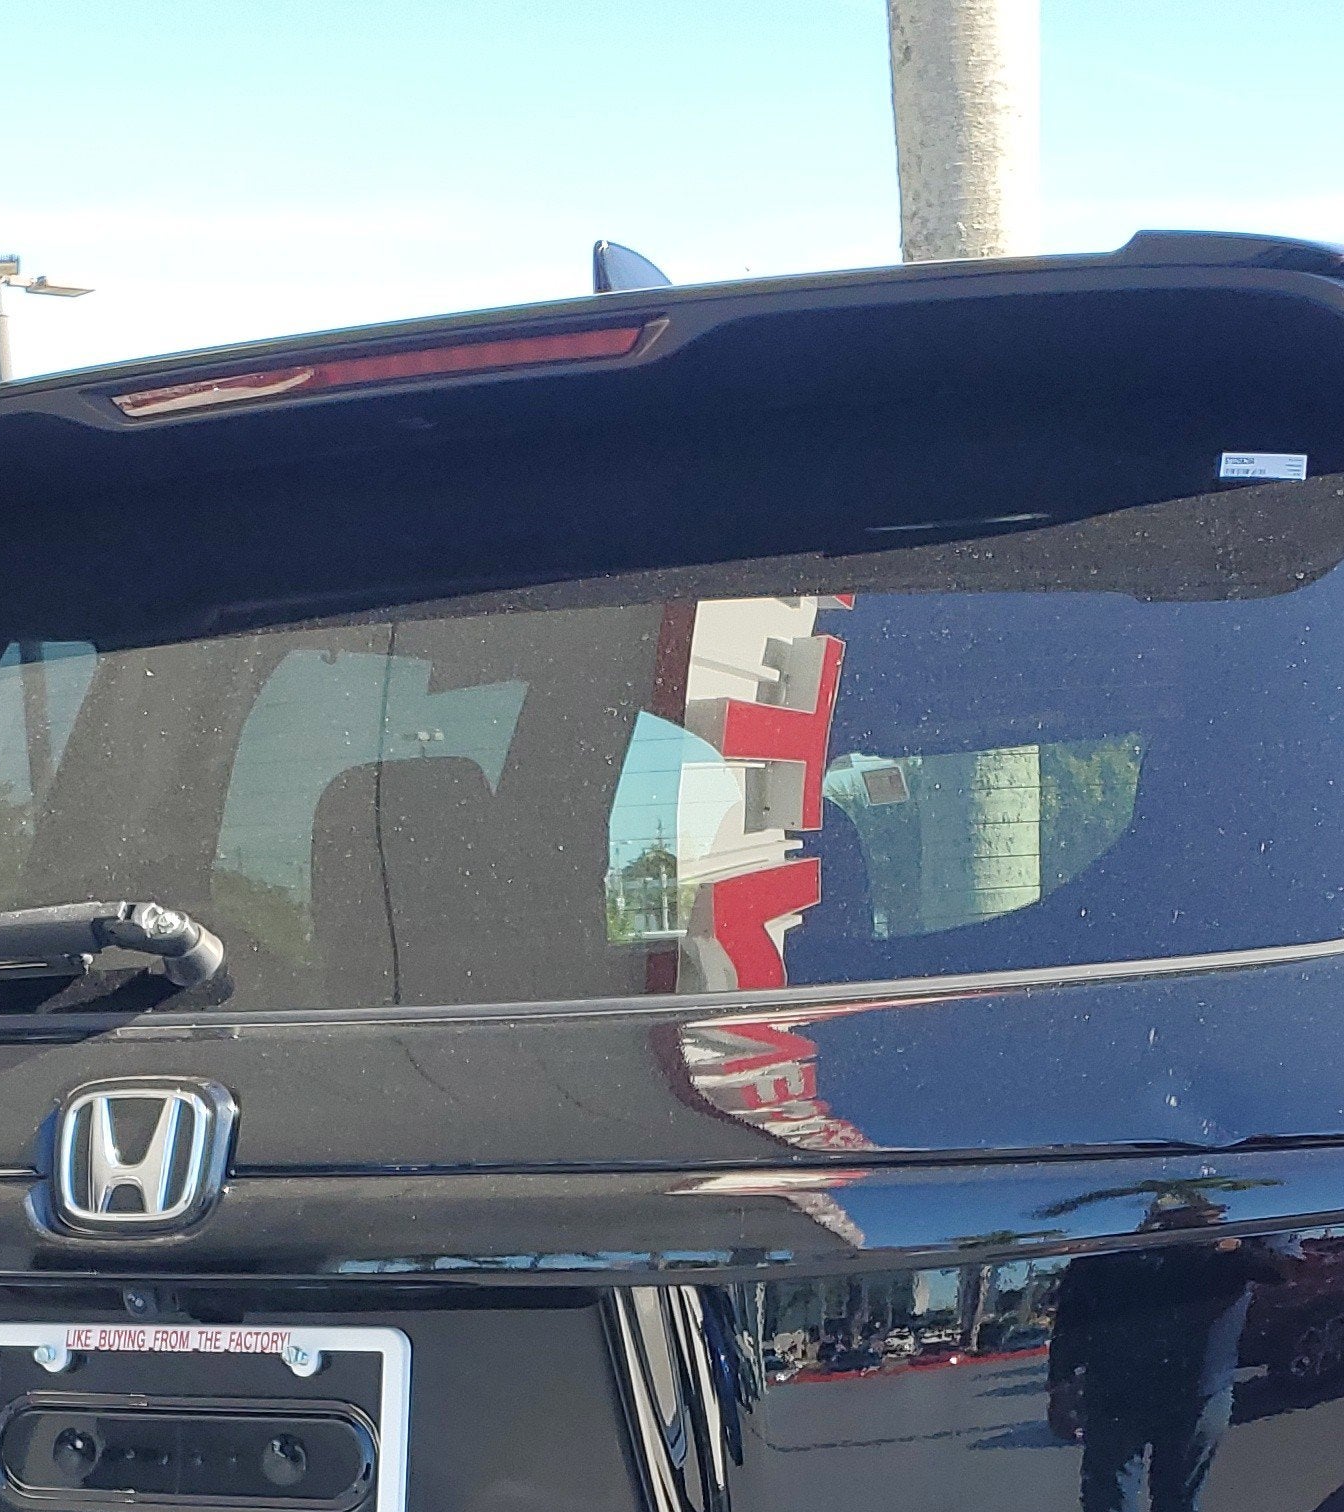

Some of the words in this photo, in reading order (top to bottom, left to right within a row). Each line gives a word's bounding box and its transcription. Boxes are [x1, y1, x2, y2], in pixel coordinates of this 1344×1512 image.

[65, 1329, 93, 1348] LIKE
[98, 1329, 146, 1349] BUYING
[153, 1330, 190, 1349] FROM
[197, 1331, 222, 1350] THE
